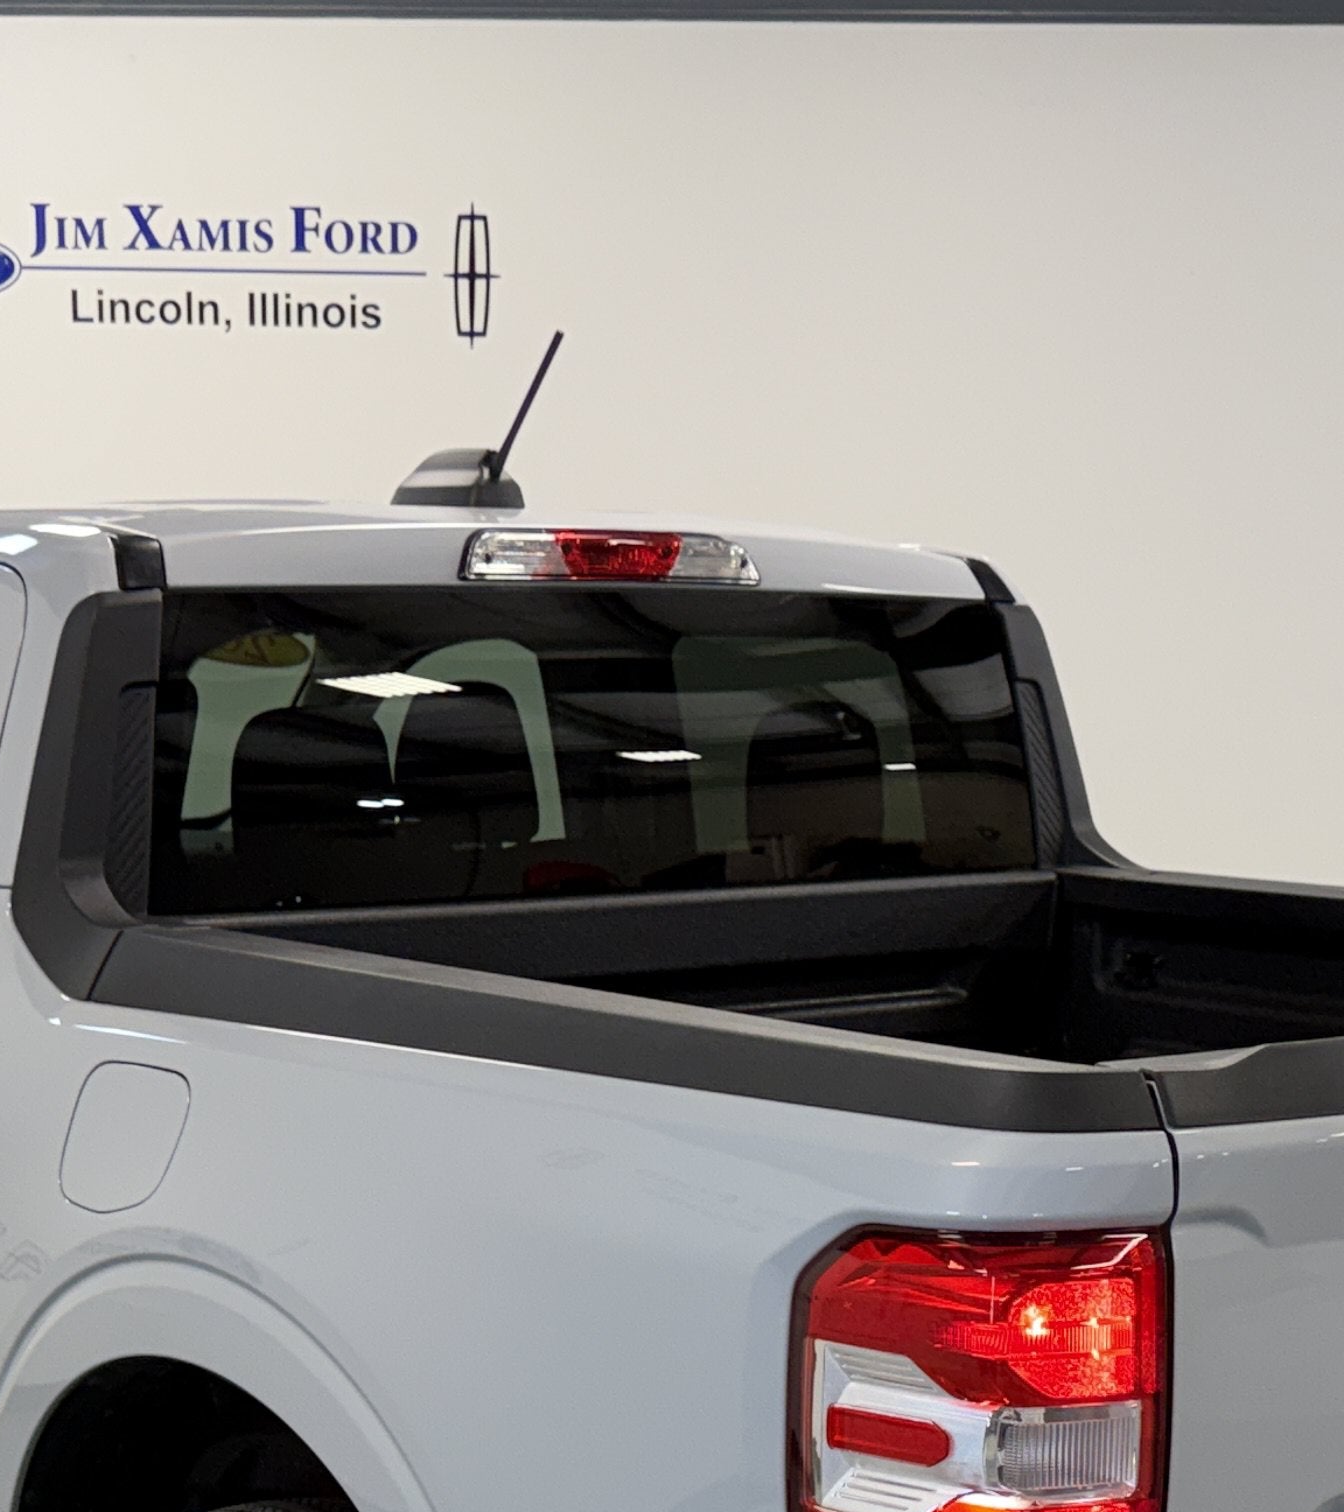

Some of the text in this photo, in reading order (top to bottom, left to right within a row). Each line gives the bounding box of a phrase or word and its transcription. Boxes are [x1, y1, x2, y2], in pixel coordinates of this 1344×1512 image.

[30, 203, 419, 258] JIM XAMIS FORD
[71, 289, 382, 331] Lincoln, Illinois
